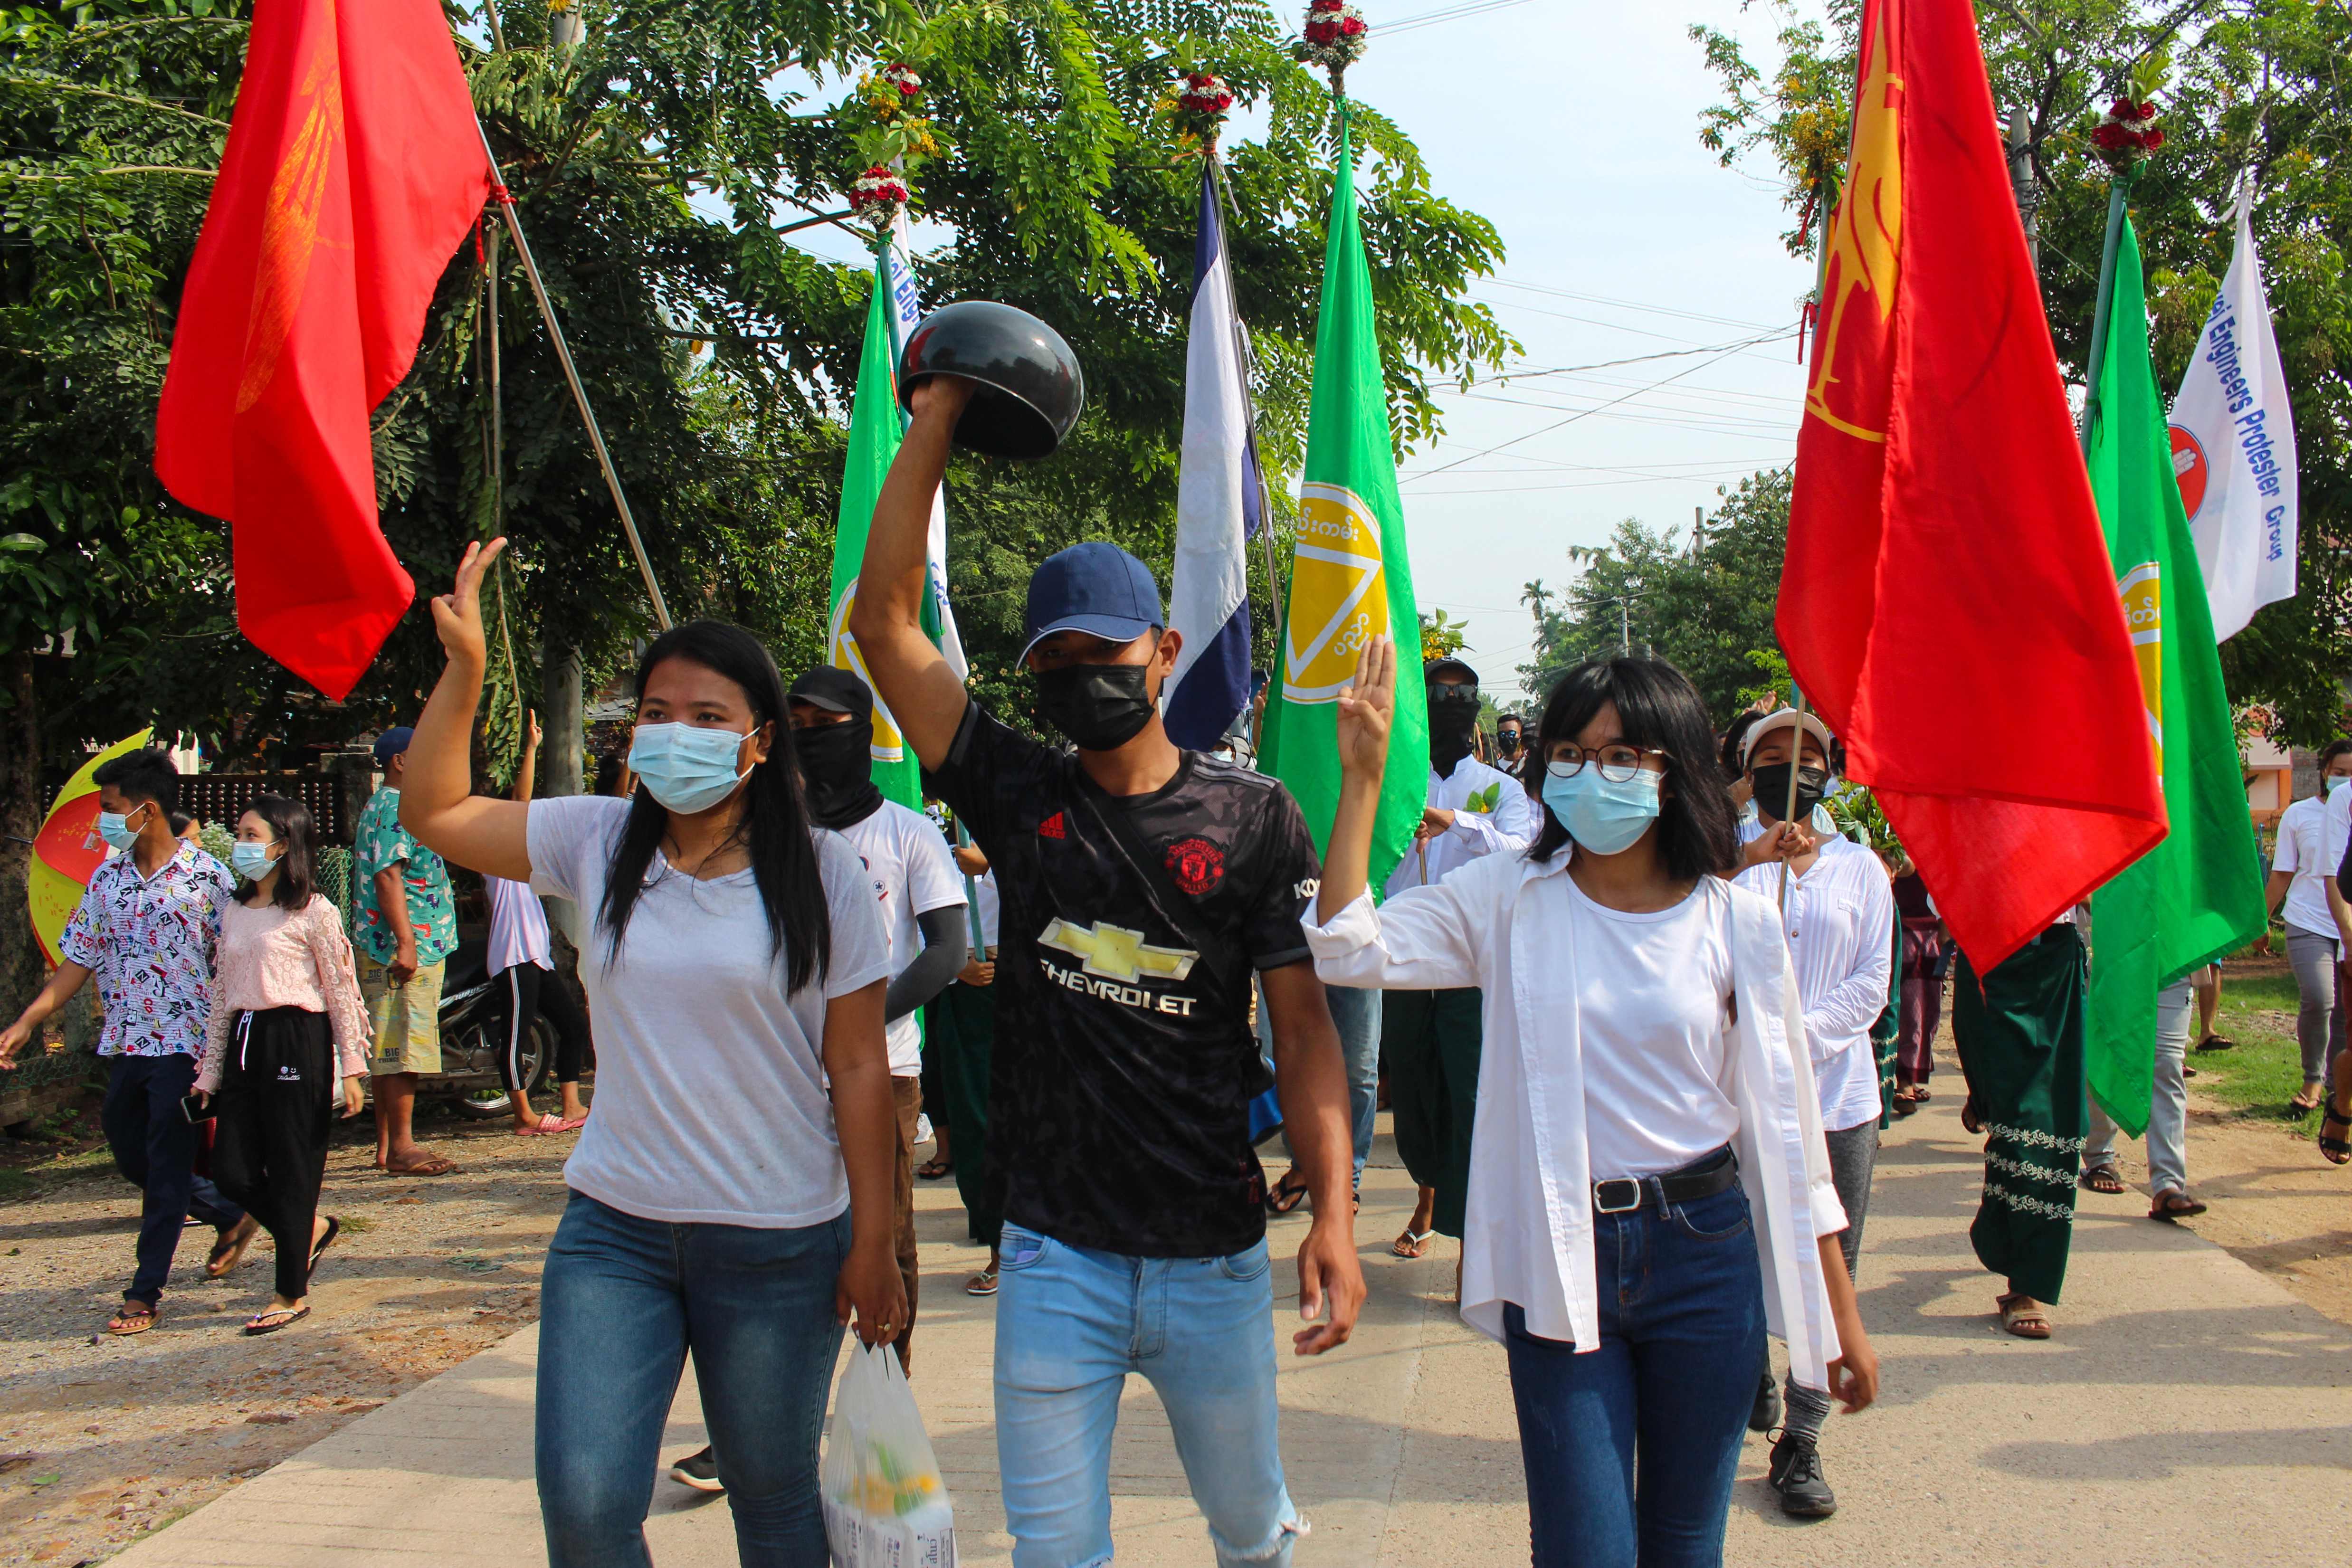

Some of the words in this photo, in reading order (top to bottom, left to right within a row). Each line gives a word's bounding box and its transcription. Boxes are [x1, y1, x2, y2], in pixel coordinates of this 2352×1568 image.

[2206, 316, 2253, 413] Engineers
[2234, 409, 2282, 497] Protester
[2265, 505, 2285, 561] Group
[385, 1048, 400, 1057] BIG
